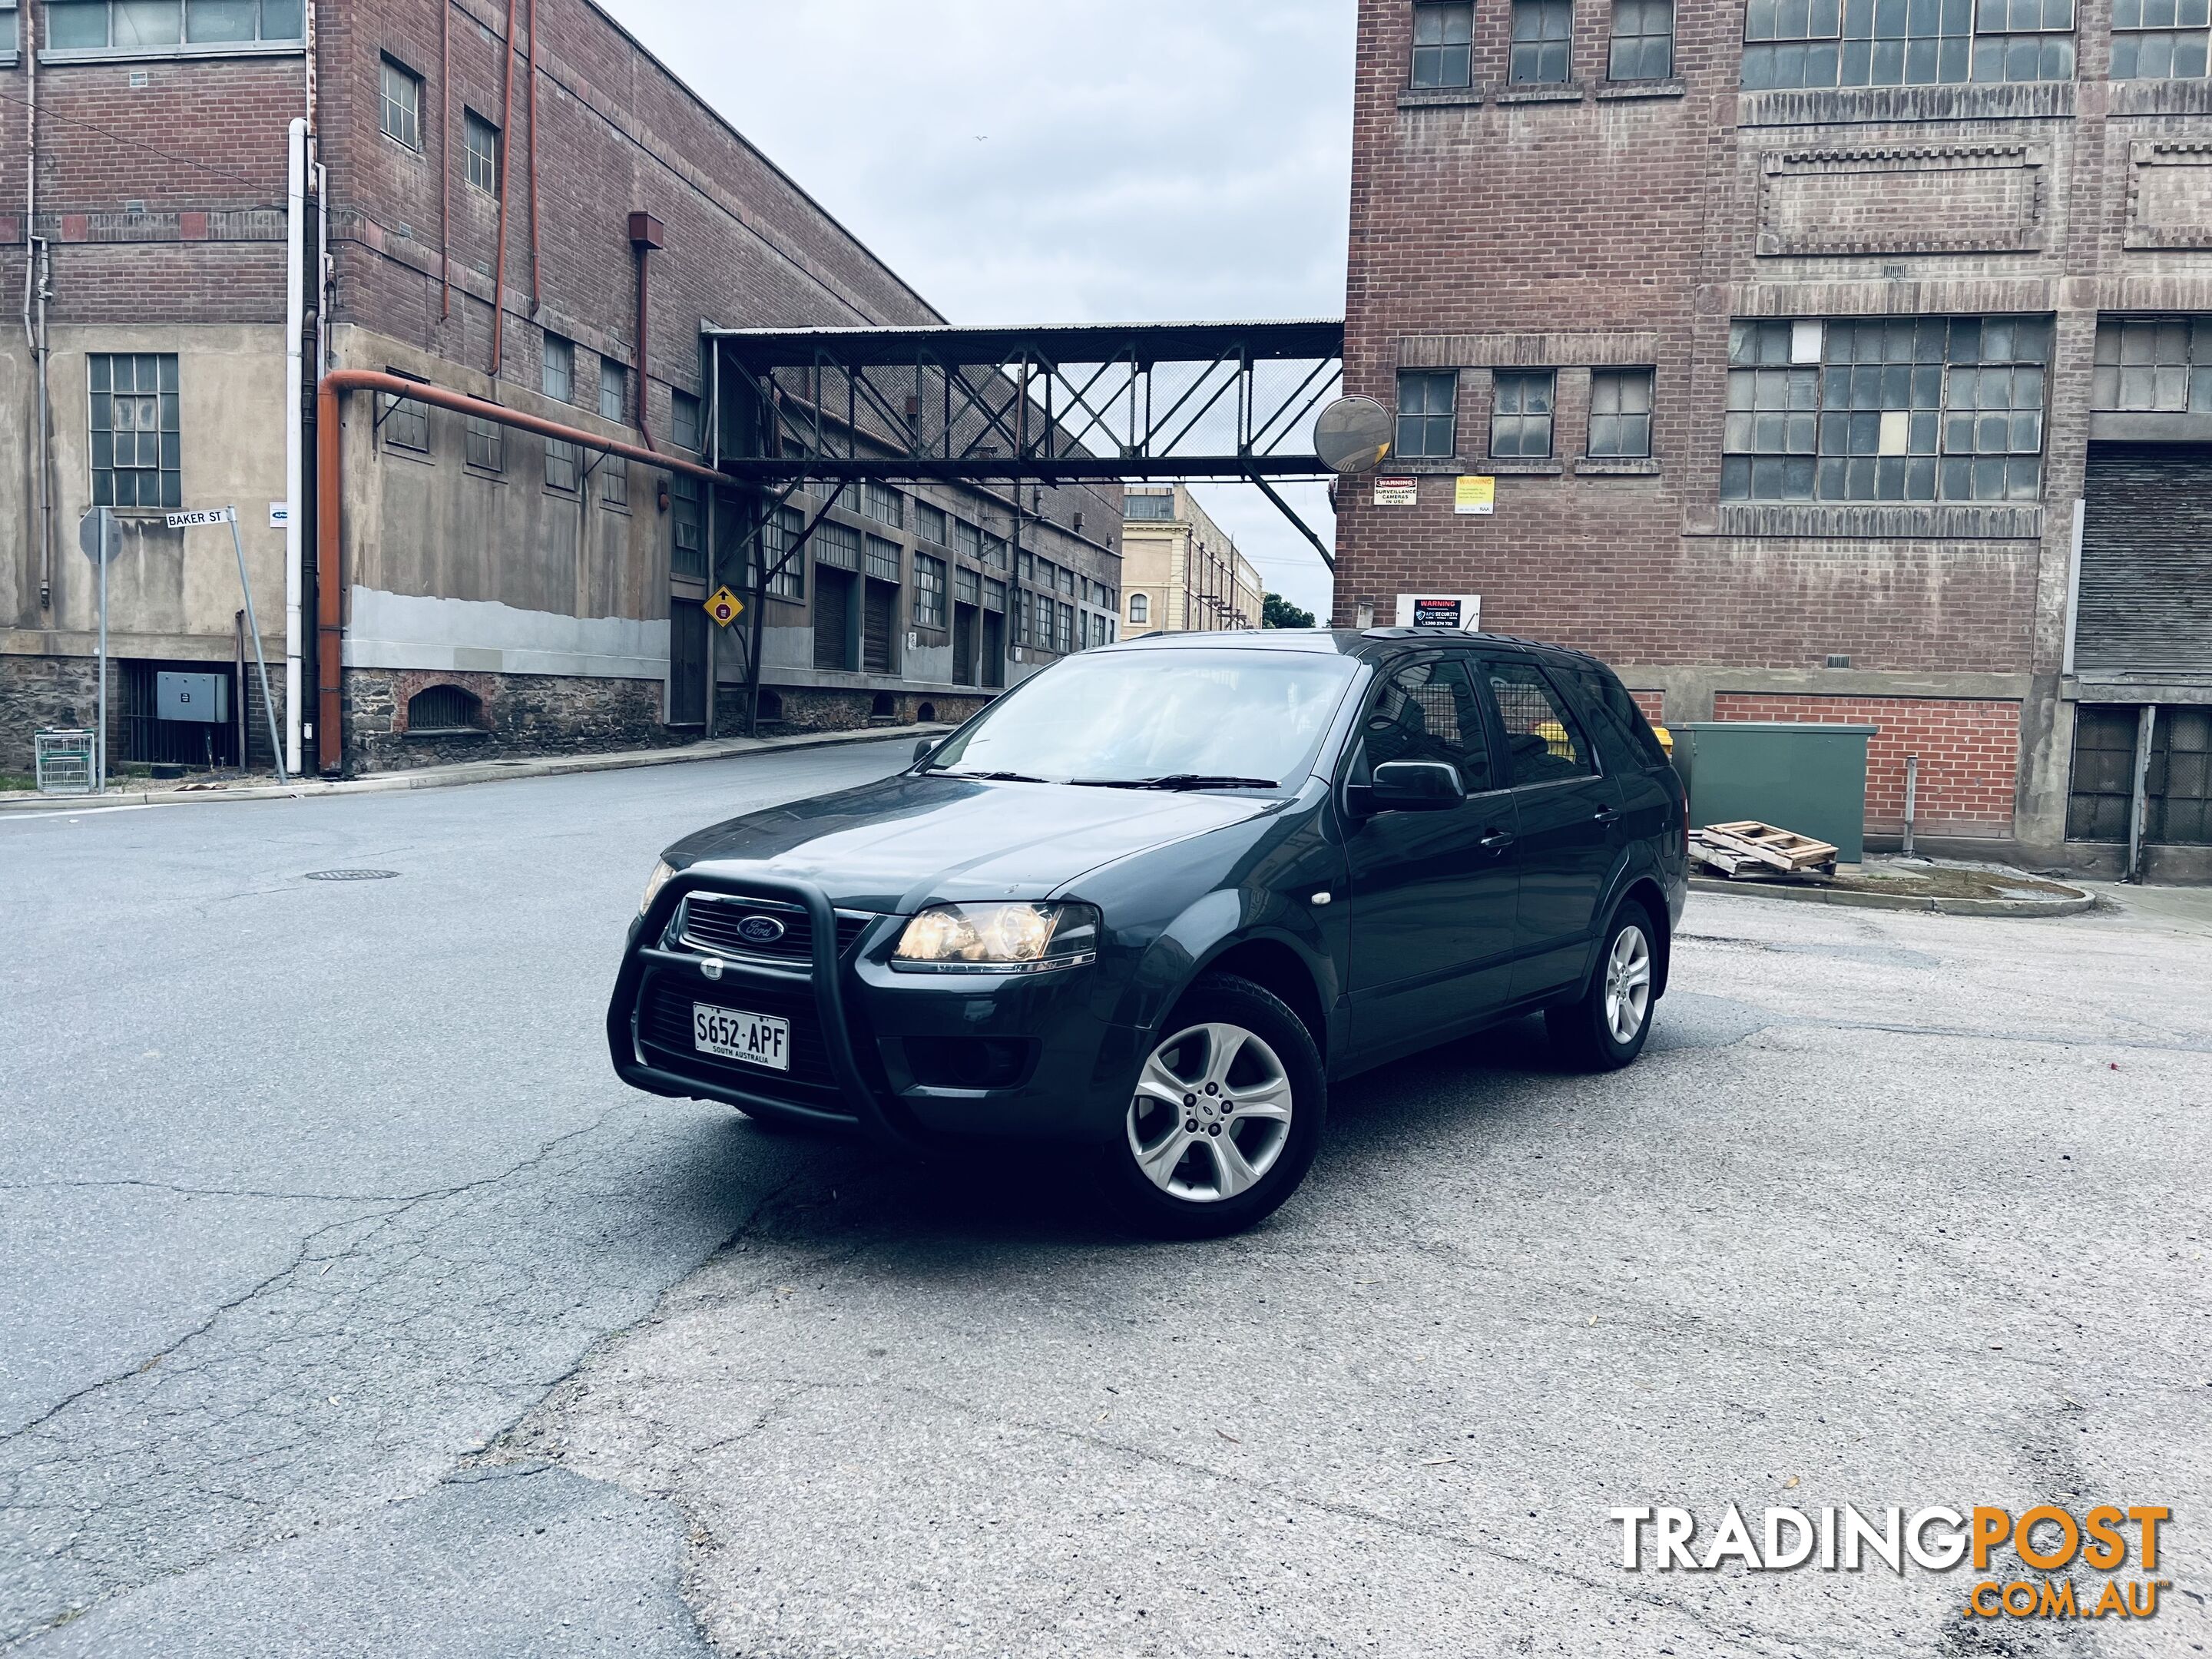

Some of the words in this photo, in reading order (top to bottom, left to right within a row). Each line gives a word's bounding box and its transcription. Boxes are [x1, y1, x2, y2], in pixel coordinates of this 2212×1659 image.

[169, 513, 205, 526] BAKER
[210, 512, 221, 522] ST
[746, 920, 773, 936] Ford
[713, 1045, 733, 1056] SOUTH
[735, 1051, 769, 1064] AUSTRALIA
